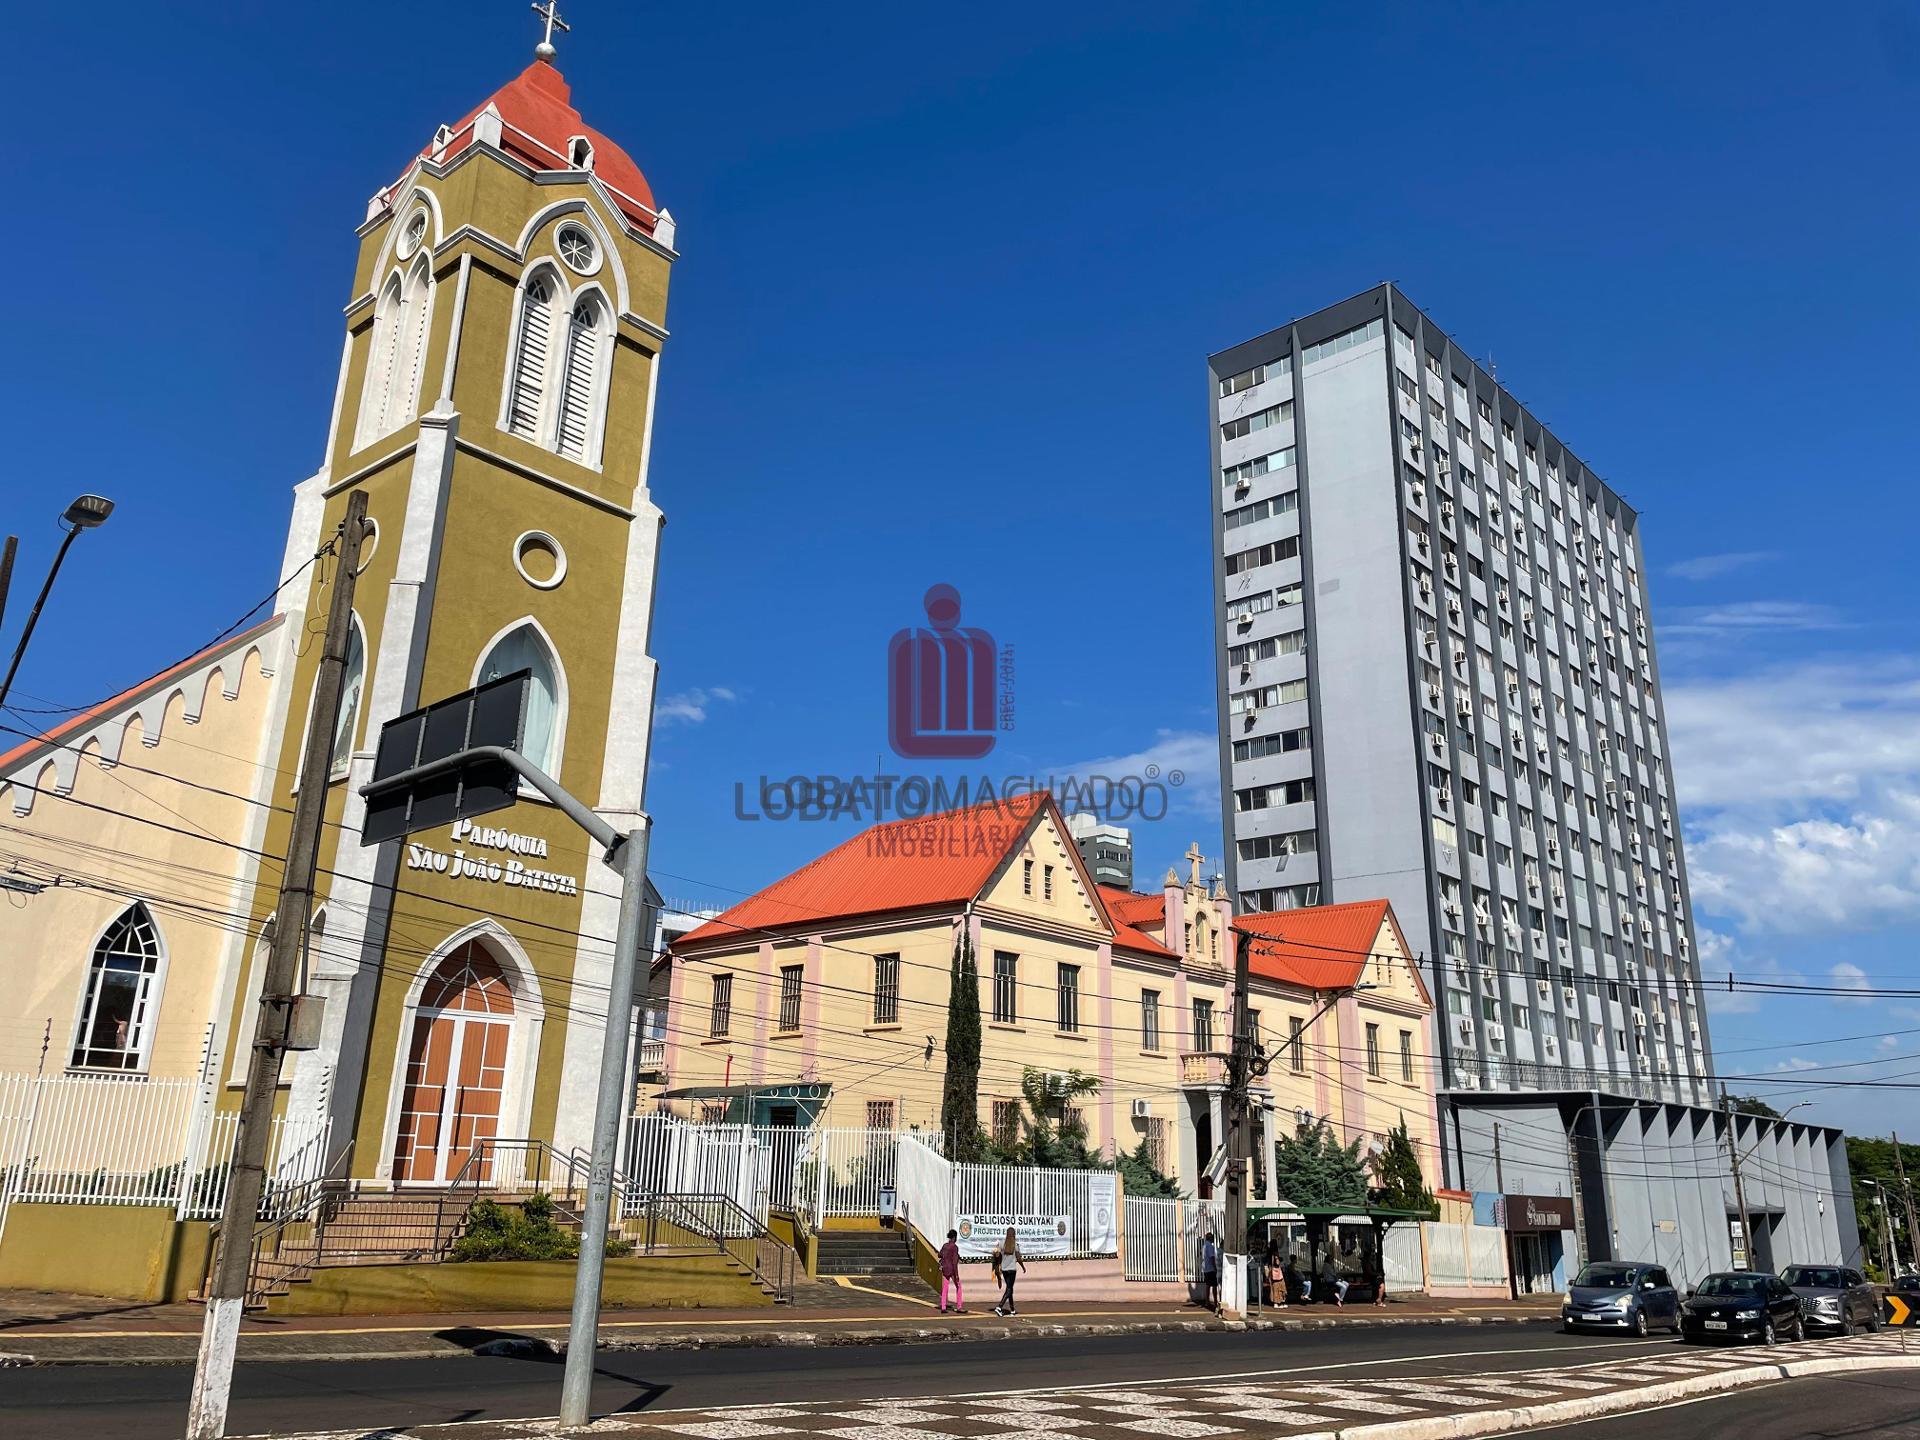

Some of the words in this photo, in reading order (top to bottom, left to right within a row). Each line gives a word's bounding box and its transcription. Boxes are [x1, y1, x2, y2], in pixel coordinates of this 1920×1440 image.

[974, 1215, 1016, 1225] DELICIOSO
[1018, 1216, 1054, 1226] SUKIYAKI
[973, 1227, 1001, 1235] PROJETO
